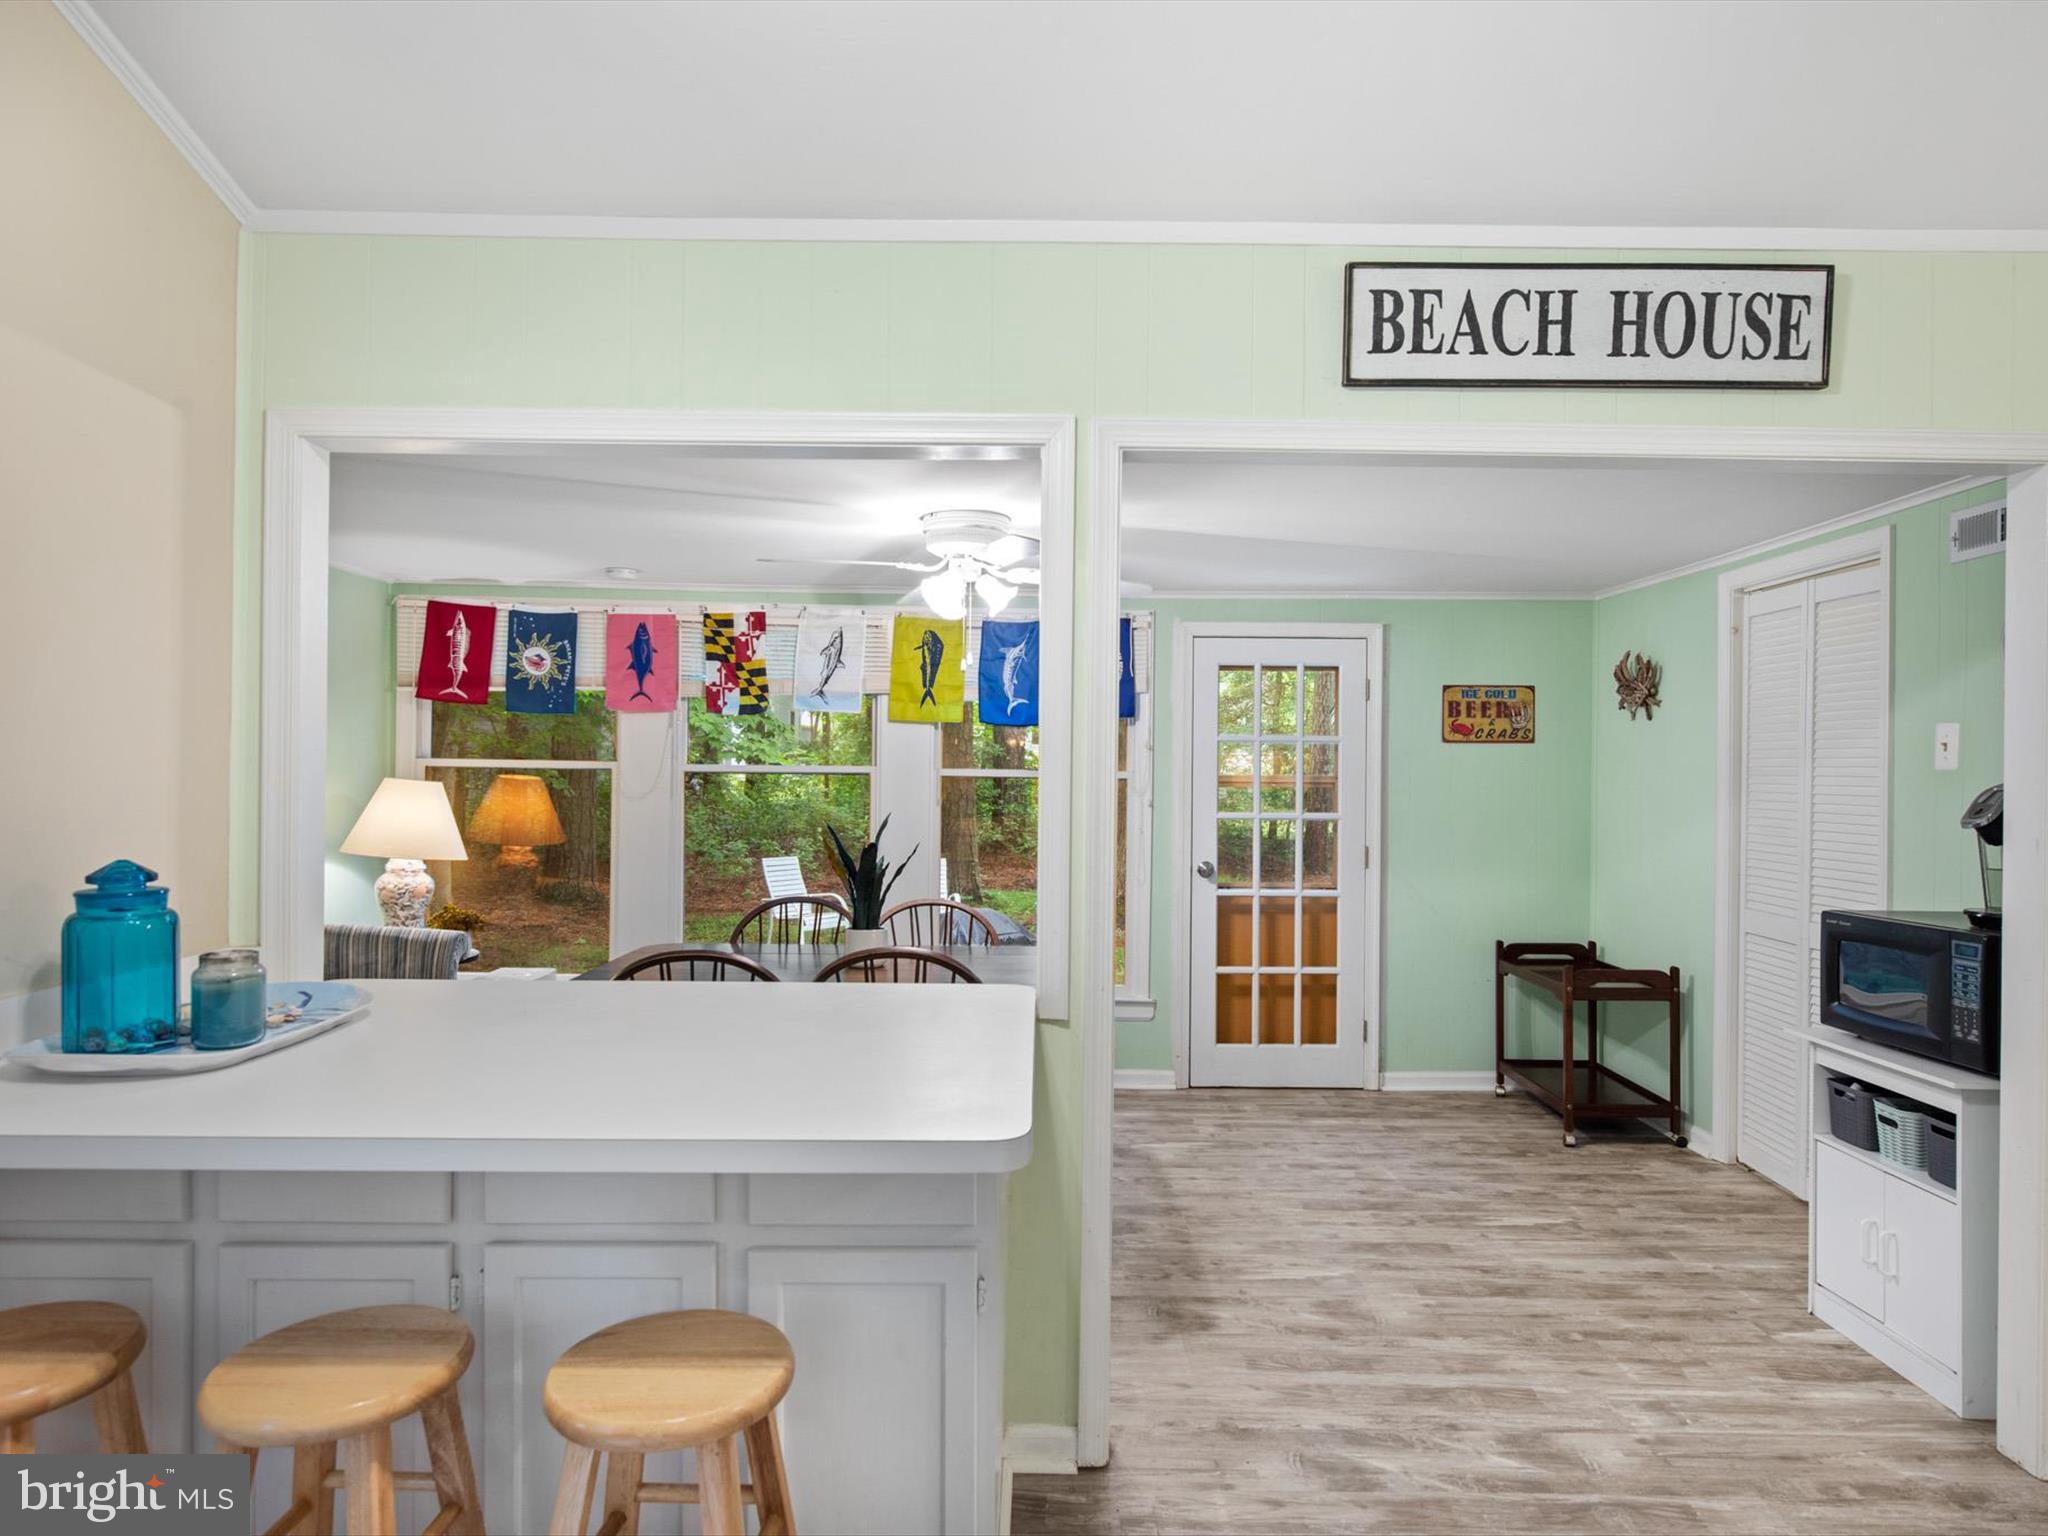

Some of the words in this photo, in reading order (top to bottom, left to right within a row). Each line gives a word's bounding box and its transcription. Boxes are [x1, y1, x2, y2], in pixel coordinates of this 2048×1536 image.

[1367, 288, 1578, 356] BEACH
[1607, 290, 1812, 361] HOUSE
[1461, 689, 1480, 699] ICE
[1485, 689, 1517, 699] COLD
[1448, 700, 1510, 718] BEER
[1474, 728, 1531, 739] CRABS
